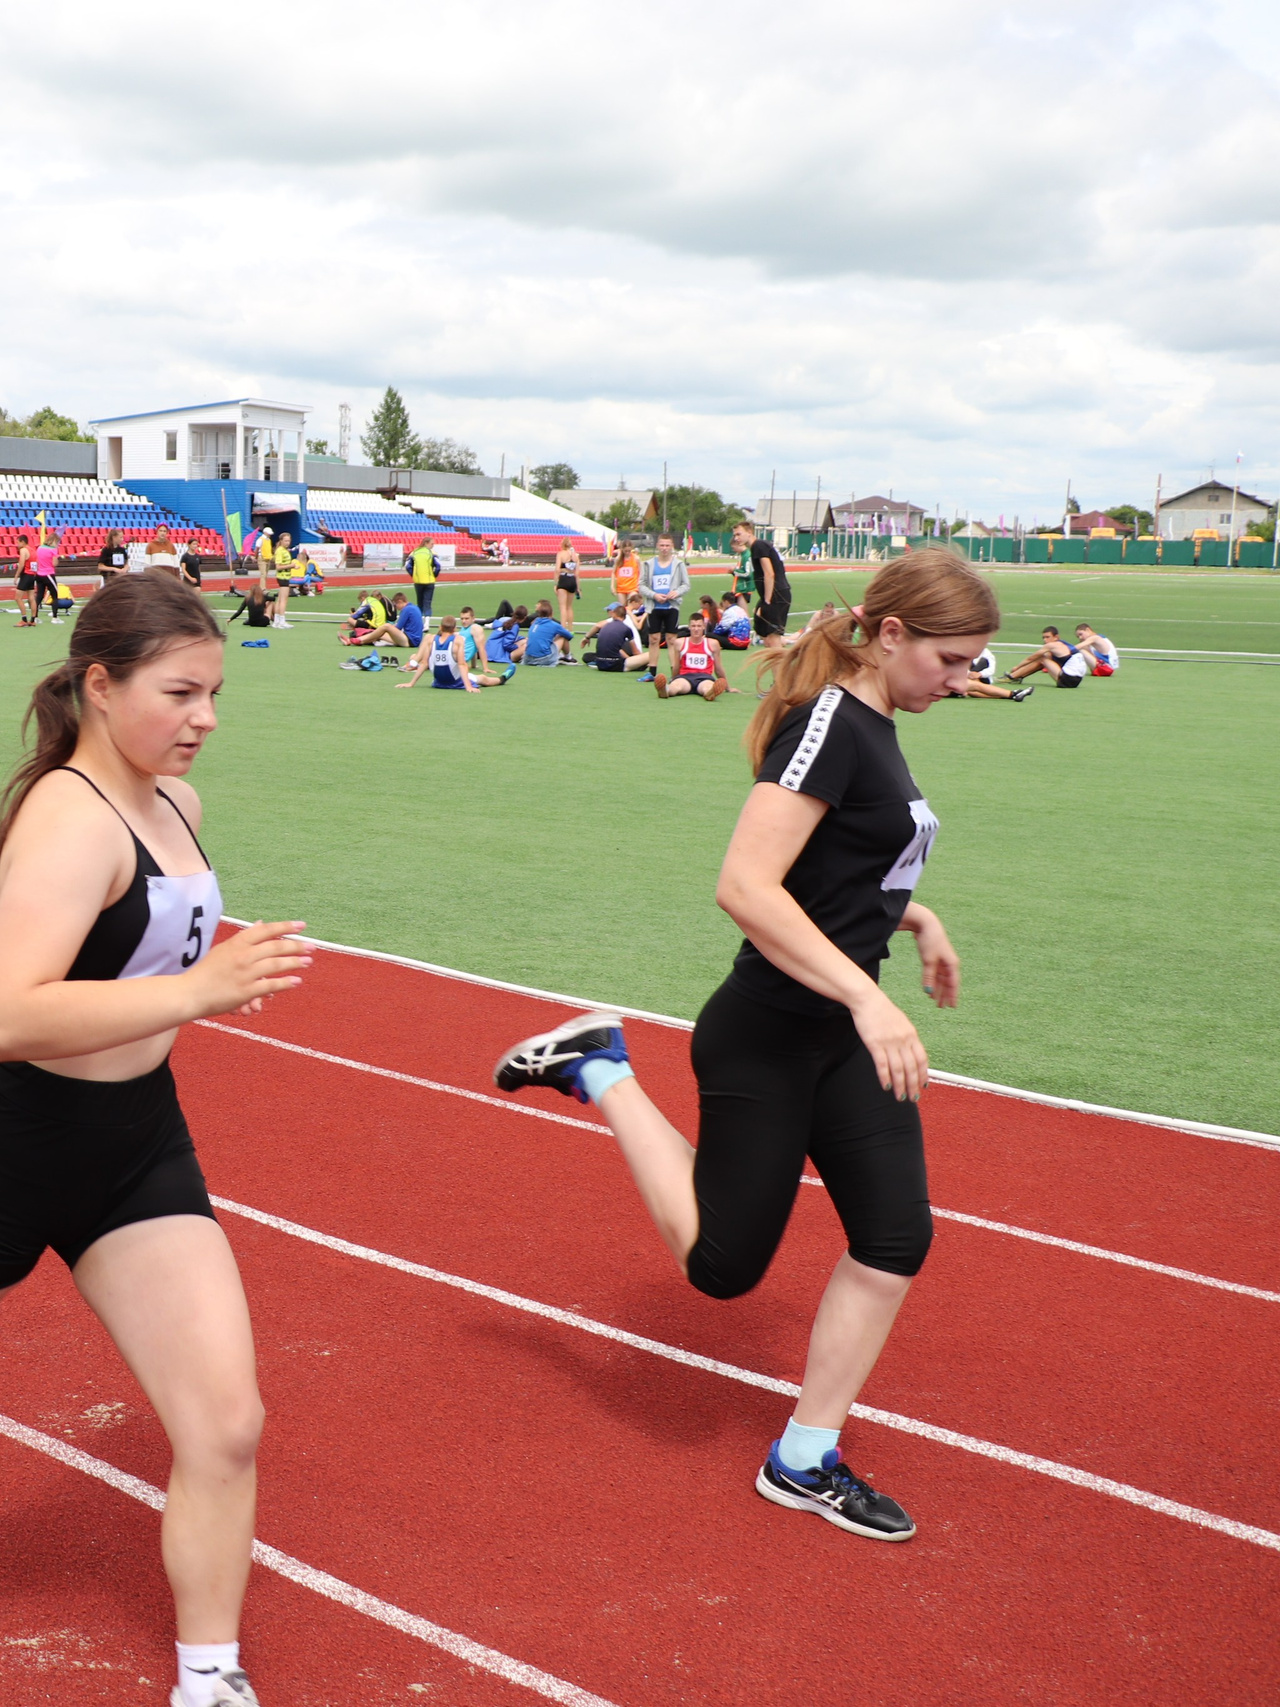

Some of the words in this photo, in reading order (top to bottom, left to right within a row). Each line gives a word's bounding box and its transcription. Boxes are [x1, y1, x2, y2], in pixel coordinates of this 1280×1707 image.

[657, 577, 668, 586] 52
[435, 653, 447, 662] 98
[688, 656, 705, 665] 188
[181, 905, 204, 968] 5
